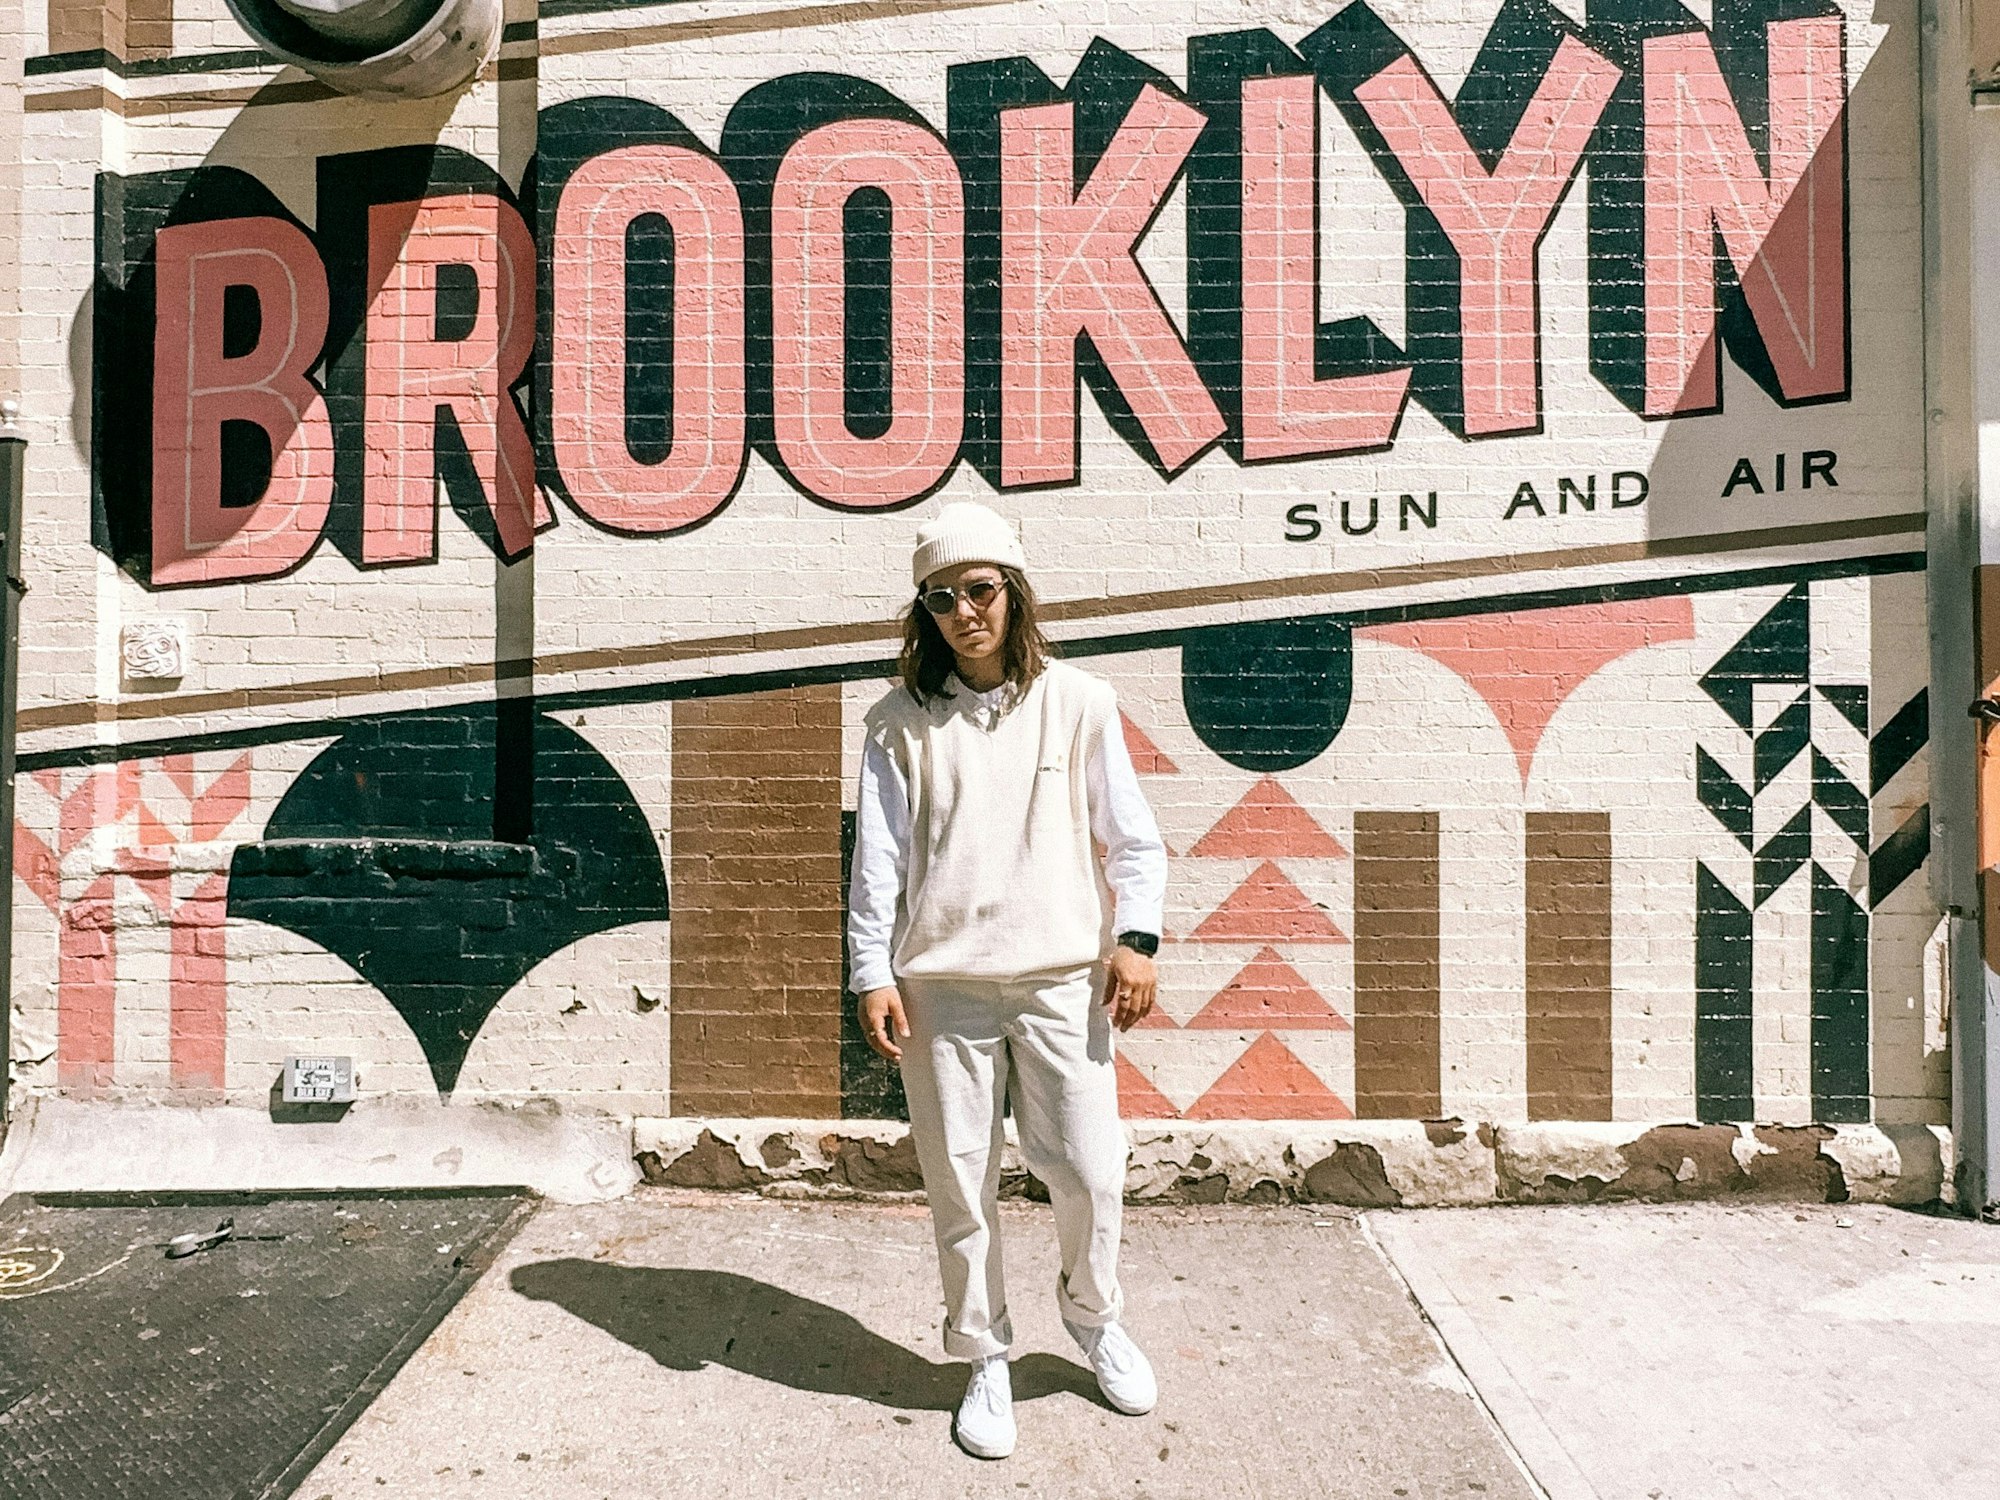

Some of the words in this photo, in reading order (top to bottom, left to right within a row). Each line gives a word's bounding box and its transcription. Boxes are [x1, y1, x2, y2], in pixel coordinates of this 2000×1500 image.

[146, 13, 1851, 590] BROOKLYN
[1283, 491, 1438, 542] SUN
[1502, 470, 1650, 520] AND
[1721, 449, 1839, 498] AIR
